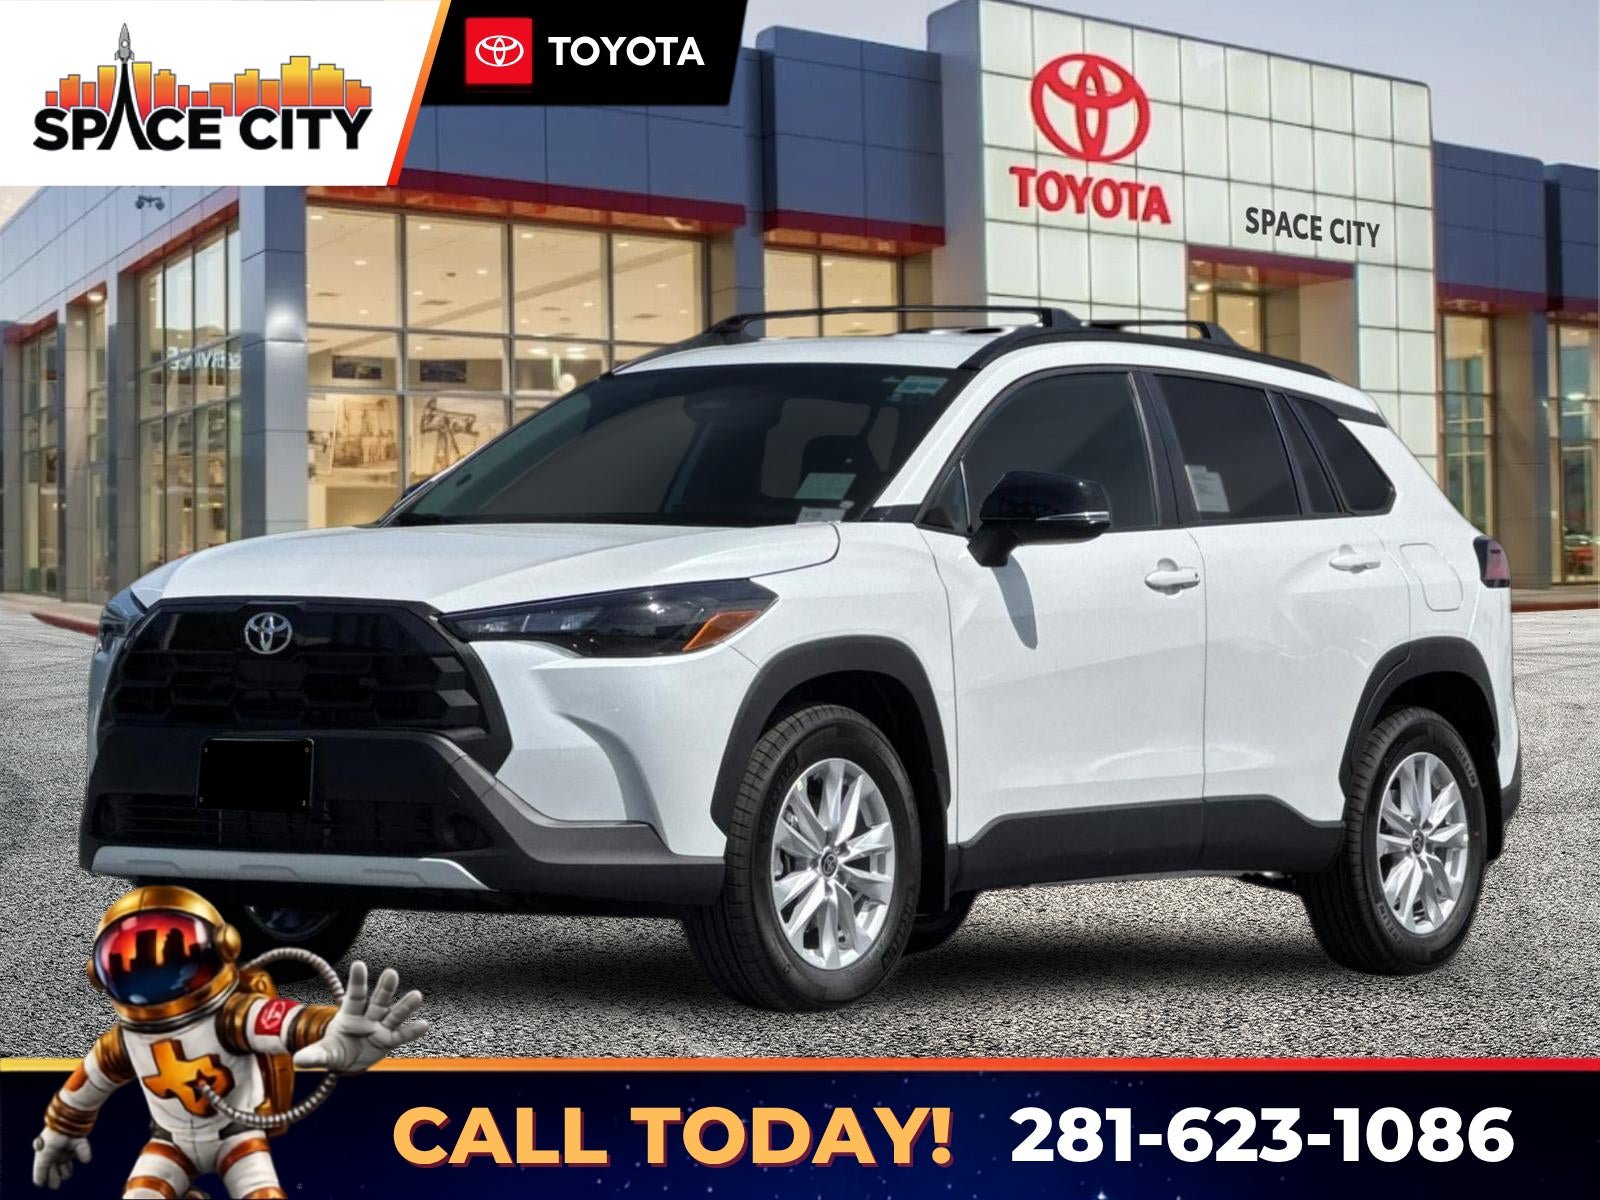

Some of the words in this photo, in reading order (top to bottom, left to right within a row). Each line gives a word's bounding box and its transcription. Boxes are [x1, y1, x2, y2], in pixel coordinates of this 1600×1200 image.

[1009, 166, 1172, 224] TOYOTA
[1245, 207, 1322, 241] SPACE
[1329, 218, 1380, 248] CITY
